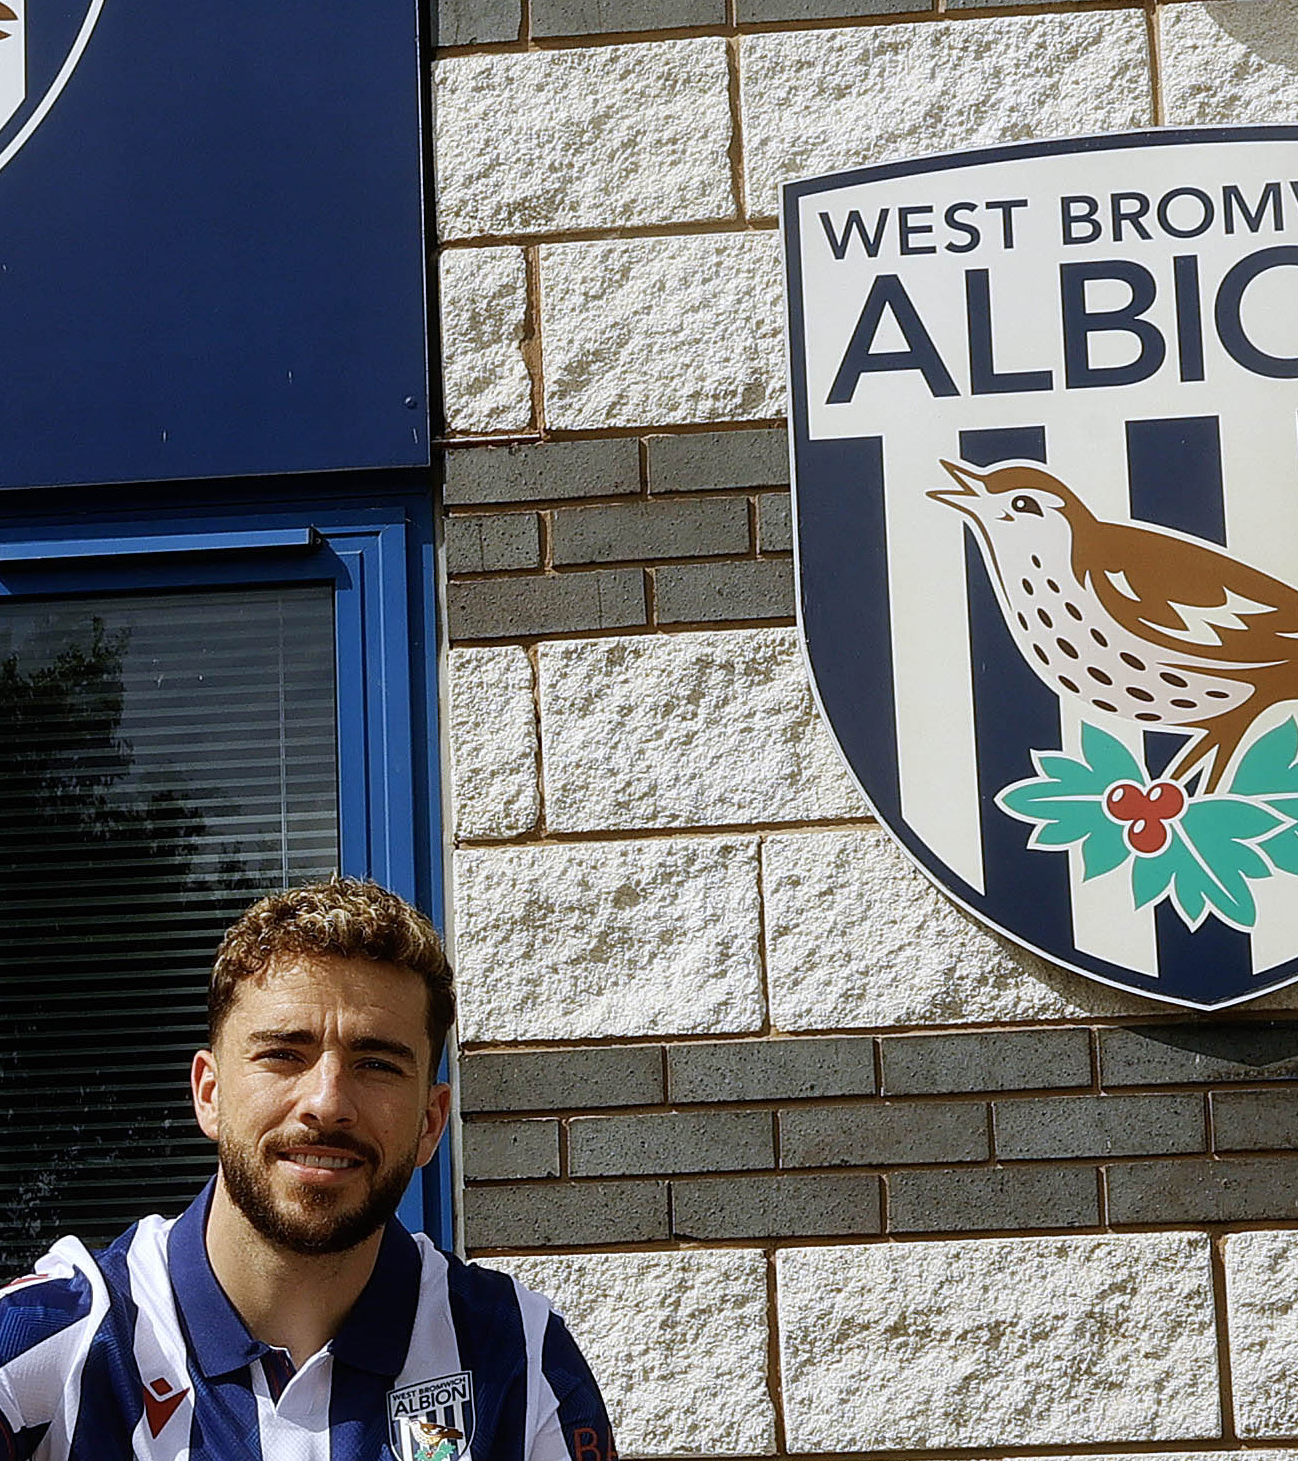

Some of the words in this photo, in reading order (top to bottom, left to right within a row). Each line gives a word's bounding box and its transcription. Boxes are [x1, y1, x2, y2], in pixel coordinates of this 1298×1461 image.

[819, 198, 1028, 260] WEST
[392, 1389, 417, 1401] WEST
[418, 1376, 466, 1395] BROMWICH
[394, 1384, 467, 1417] ALBION
